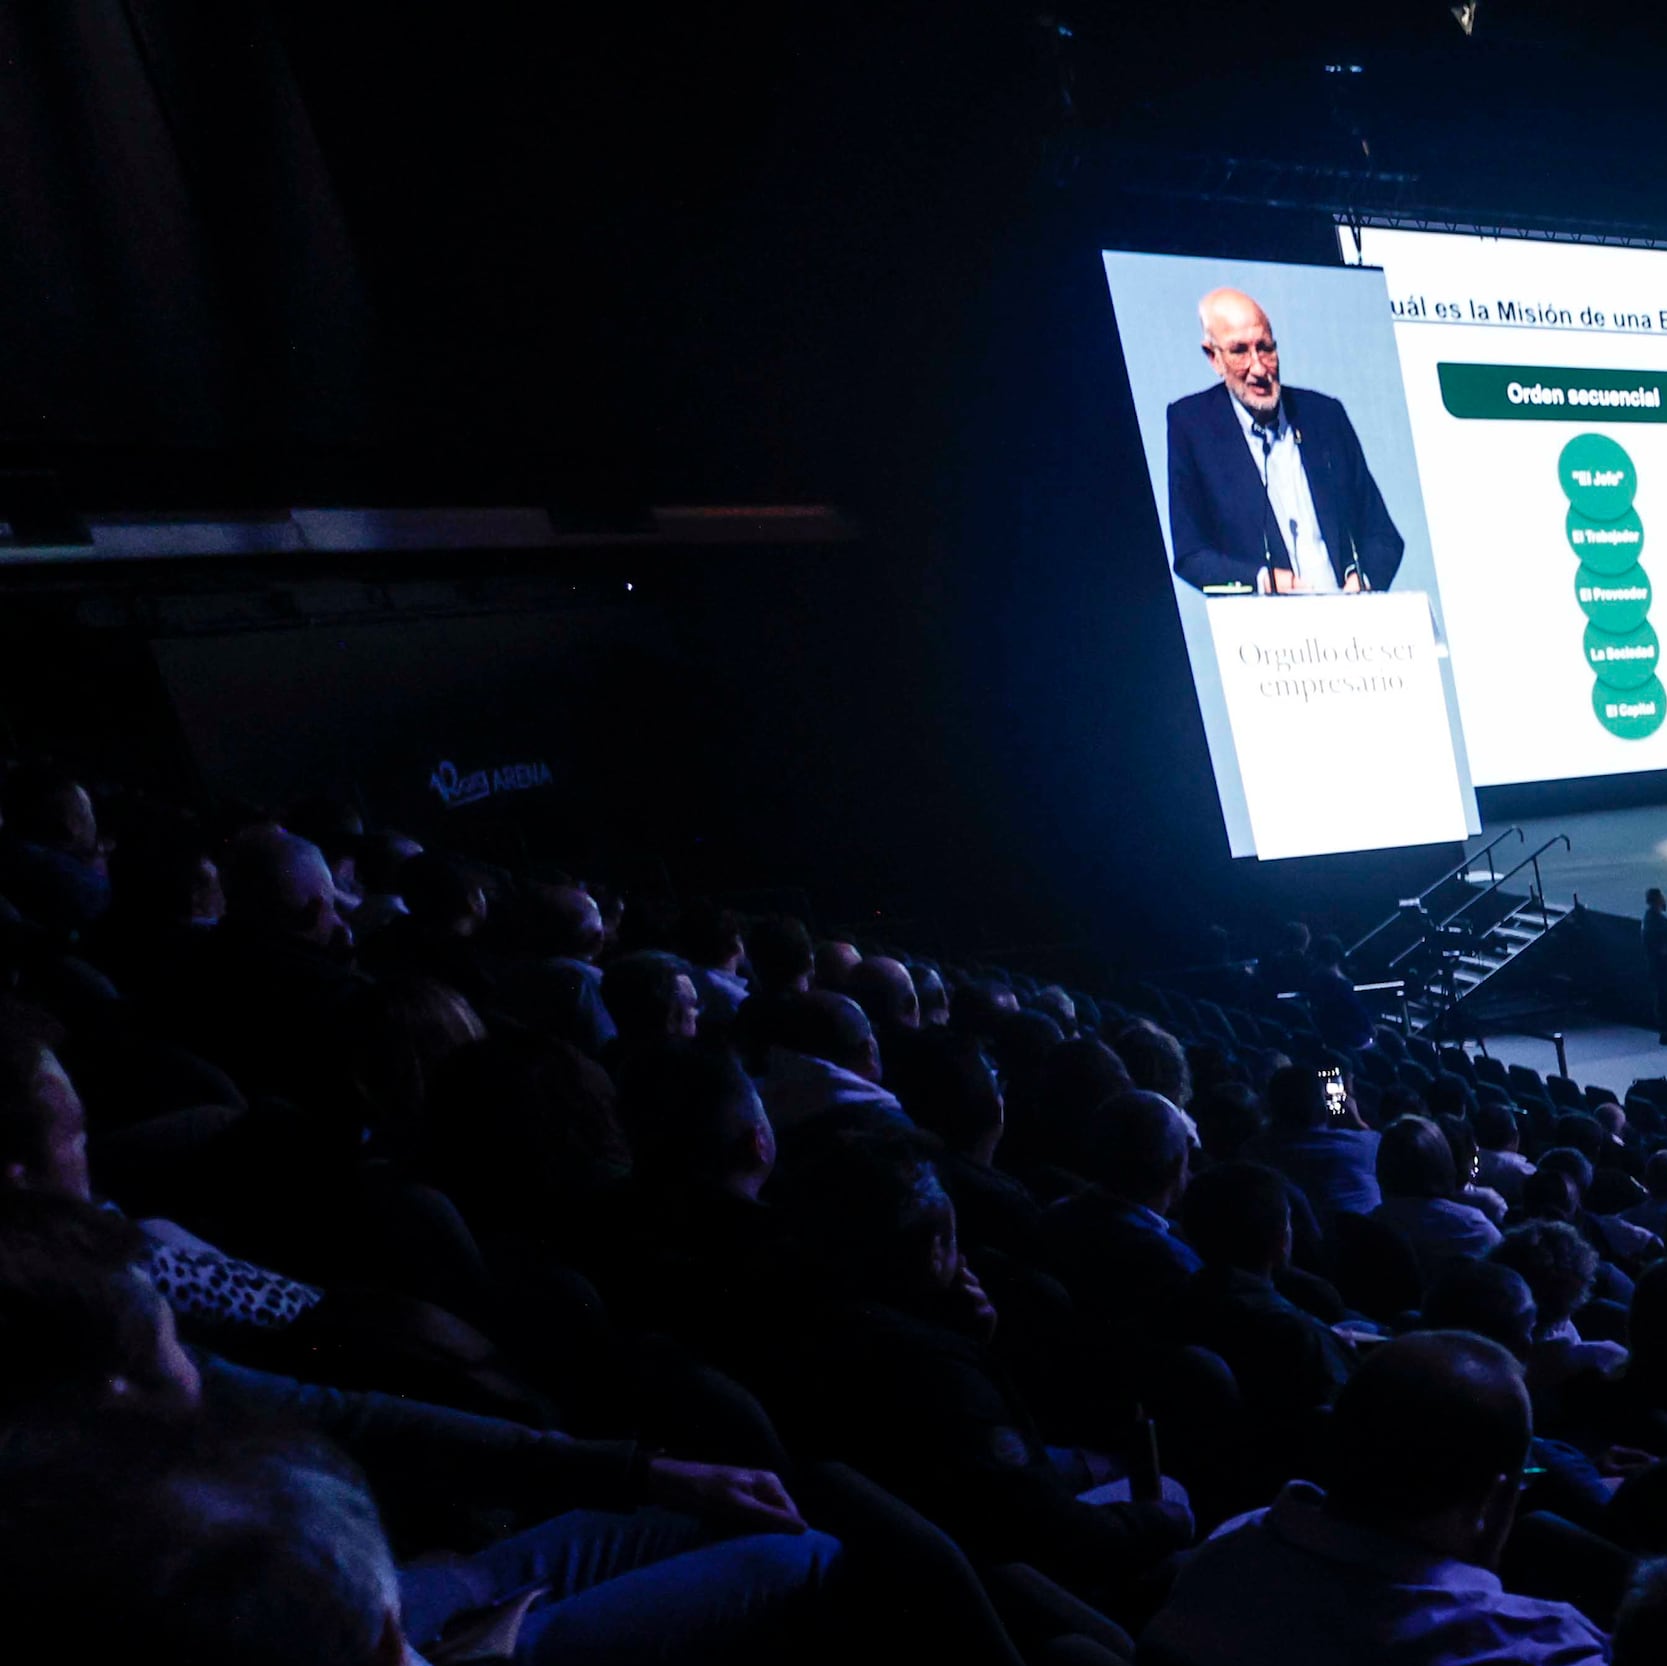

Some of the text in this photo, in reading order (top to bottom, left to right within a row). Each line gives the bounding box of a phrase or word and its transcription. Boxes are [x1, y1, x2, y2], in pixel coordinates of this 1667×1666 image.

[1390, 293, 1426, 317] uál
[1435, 302, 1462, 319] es
[1469, 299, 1490, 321] la
[1497, 300, 1572, 326] Misión
[1580, 306, 1605, 328] de
[1613, 312, 1652, 330] una
[1506, 381, 1661, 408] Orden secuencial
[1585, 528, 1640, 546] Trabajador
[1238, 635, 1415, 672] Orgullo de ser
[1606, 645, 1655, 660] Sociedad
[1259, 674, 1404, 704] empresario
[1618, 701, 1657, 718] Capital
